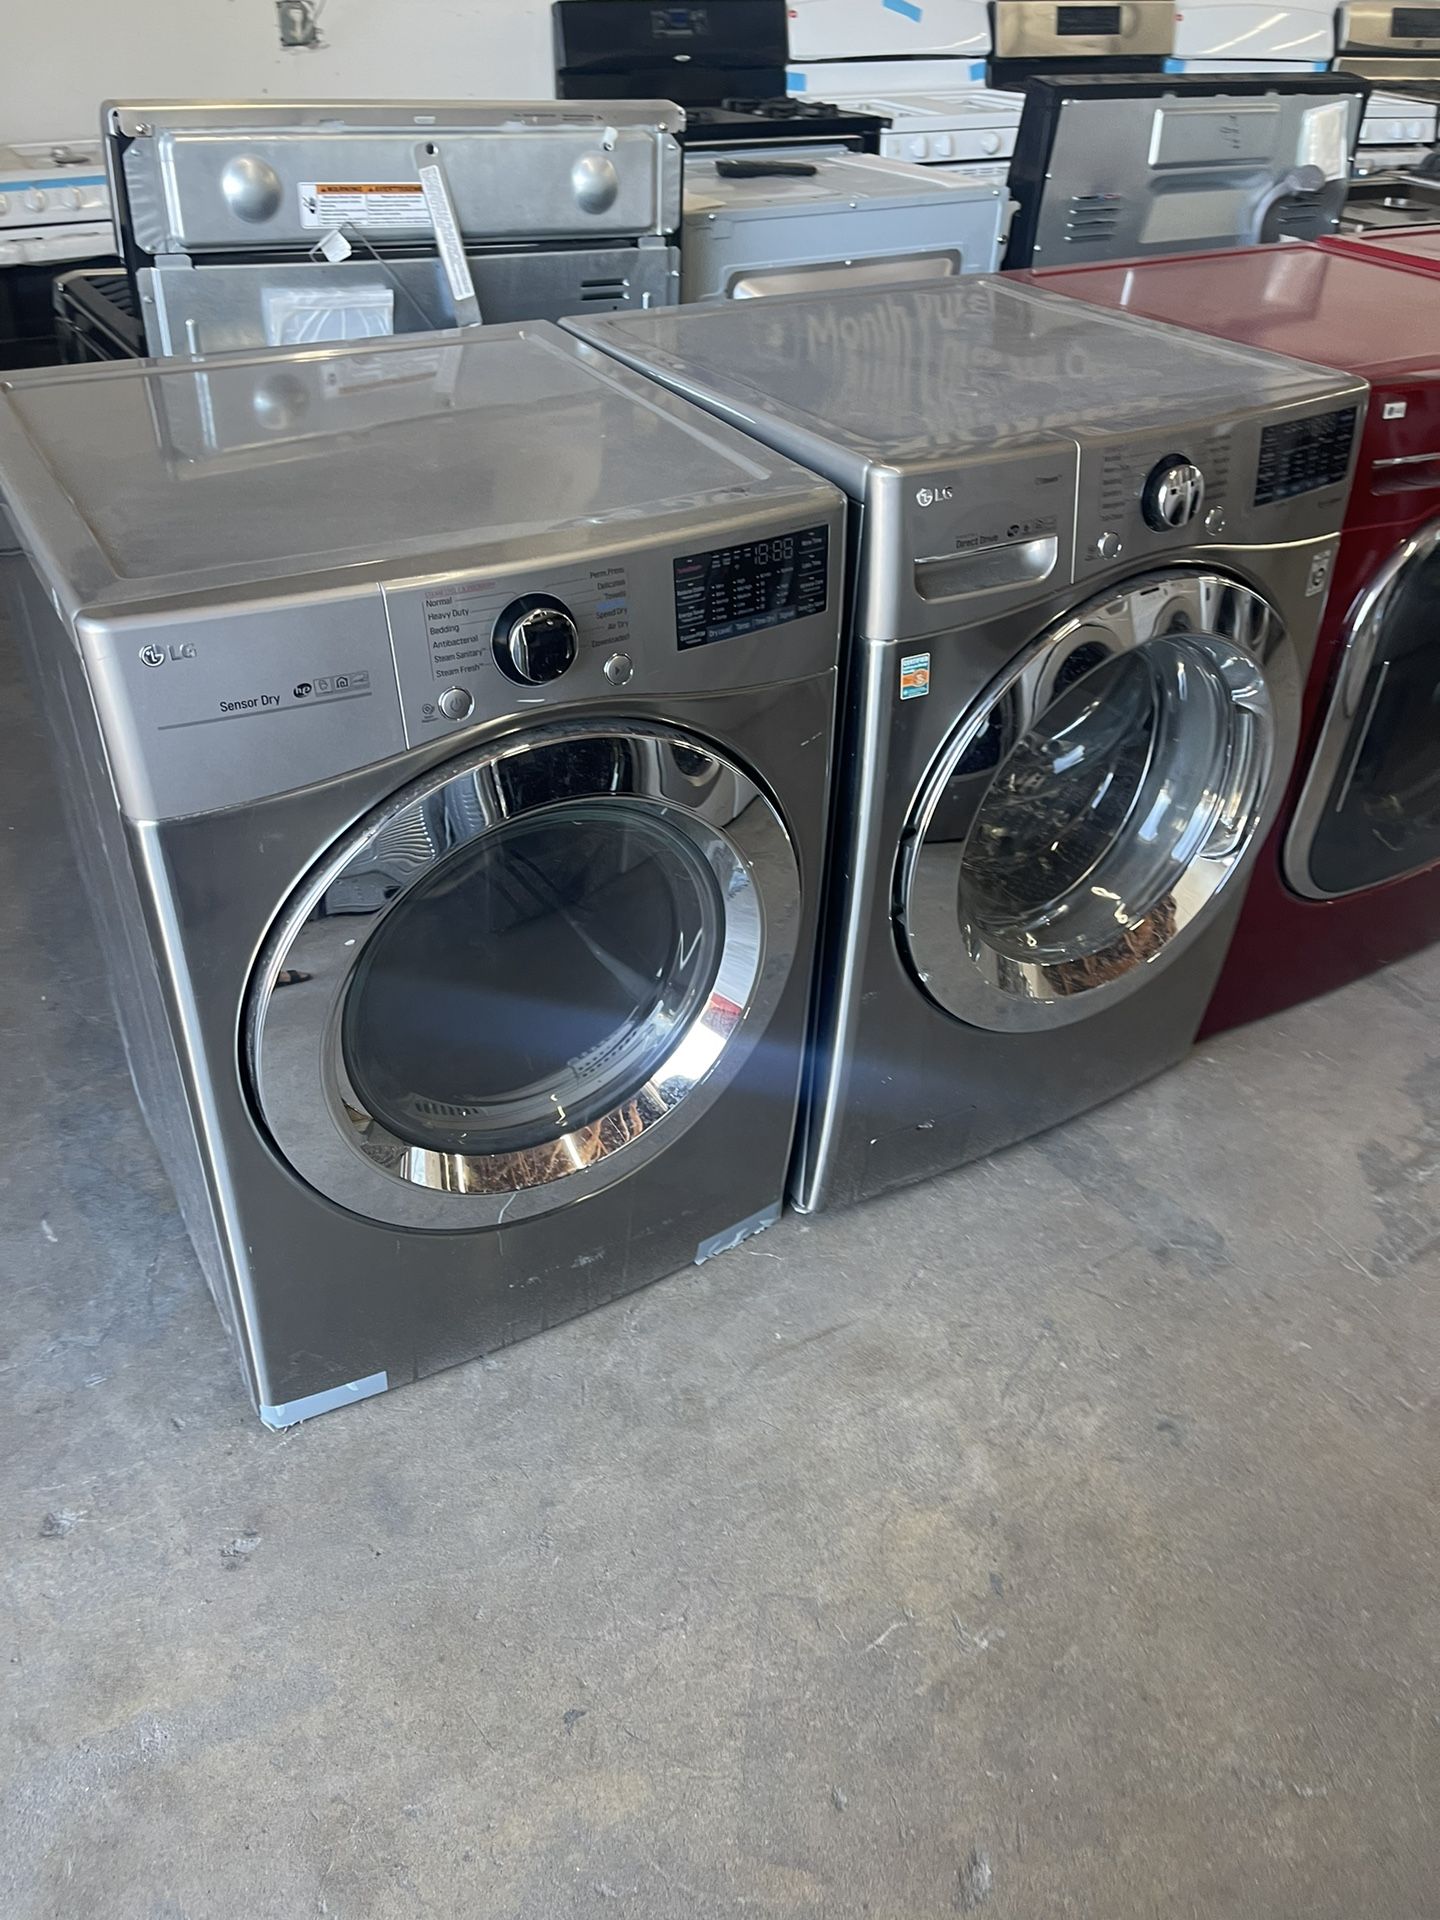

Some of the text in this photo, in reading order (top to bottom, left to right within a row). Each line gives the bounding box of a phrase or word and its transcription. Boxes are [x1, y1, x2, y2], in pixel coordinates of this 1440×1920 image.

[956, 538, 978, 549] Direct
[426, 597, 453, 608] Normal
[428, 608, 470, 621] Heavy Duty
[429, 624, 460, 636] Bedding
[433, 635, 479, 649] Antibacterial
[434, 654, 456, 664] Steam
[436, 669, 459, 678] Steam
[219, 694, 281, 712] Sensor Dry
